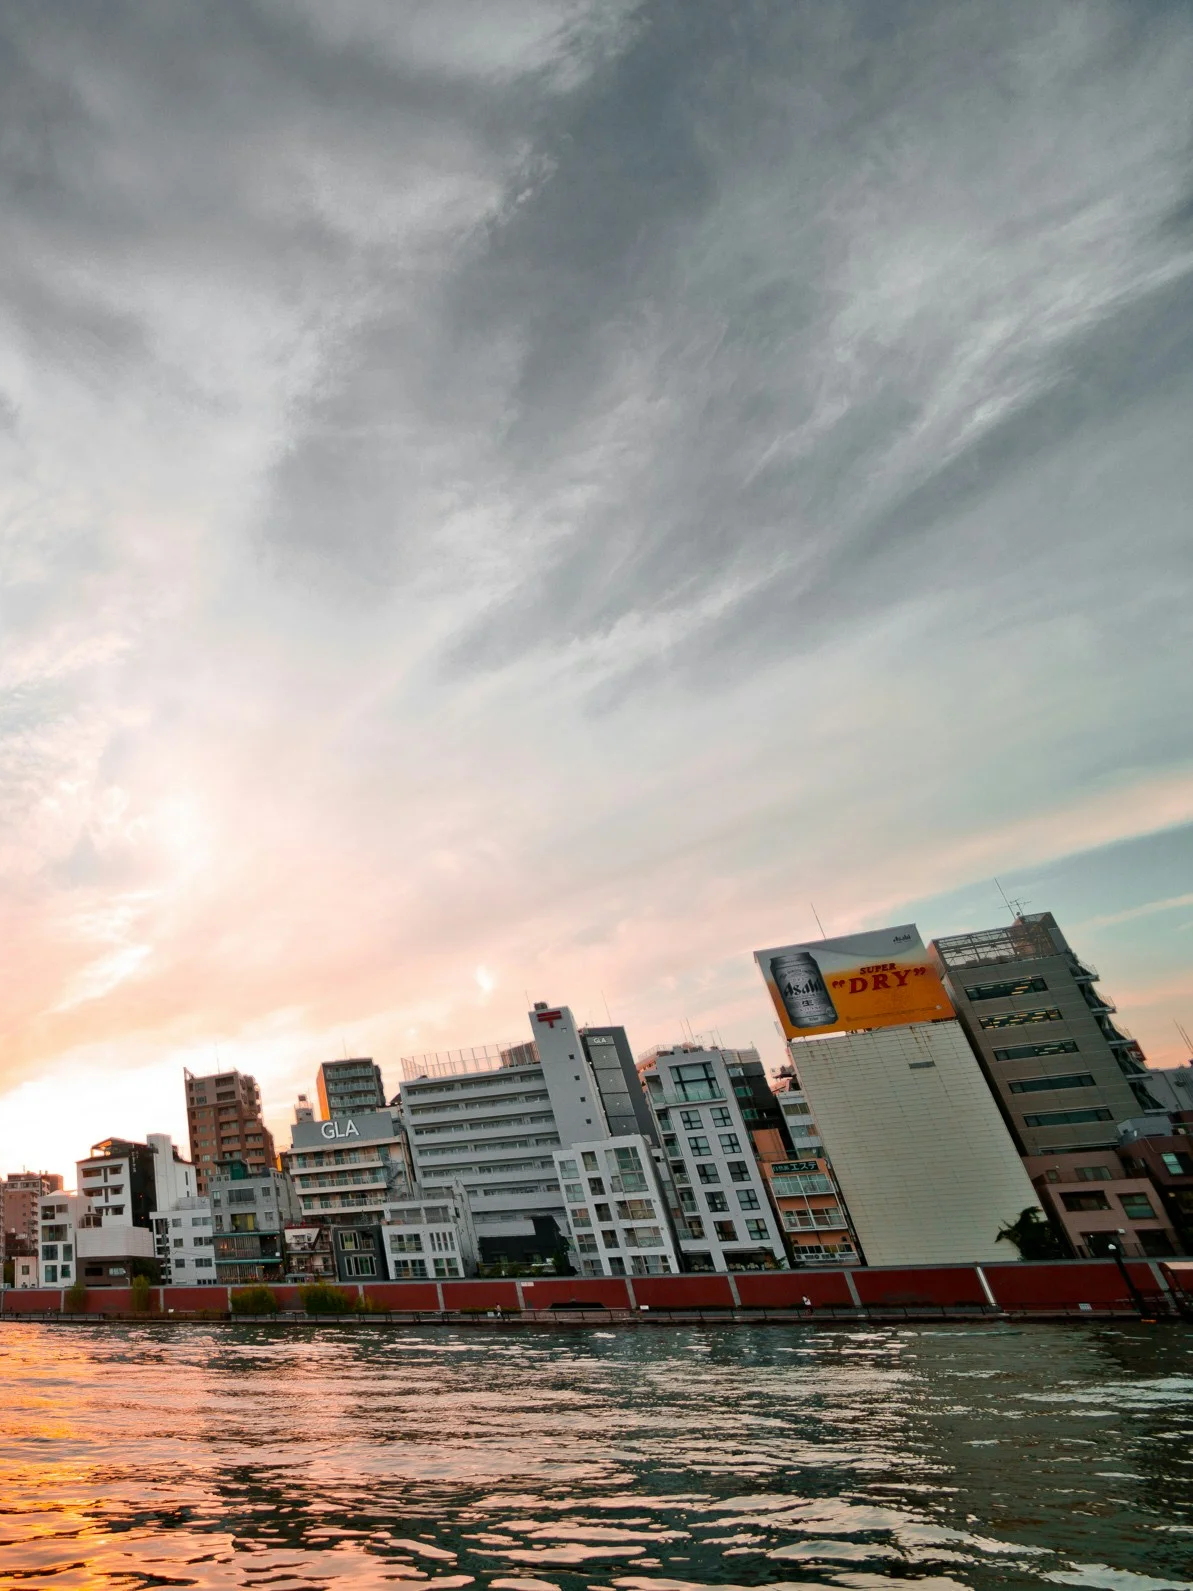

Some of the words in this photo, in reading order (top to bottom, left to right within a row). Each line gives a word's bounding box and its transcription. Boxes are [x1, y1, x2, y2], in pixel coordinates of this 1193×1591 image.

[893, 934, 911, 942] Asahi
[860, 963, 896, 974] SUPER
[321, 1120, 359, 1139] GLA
